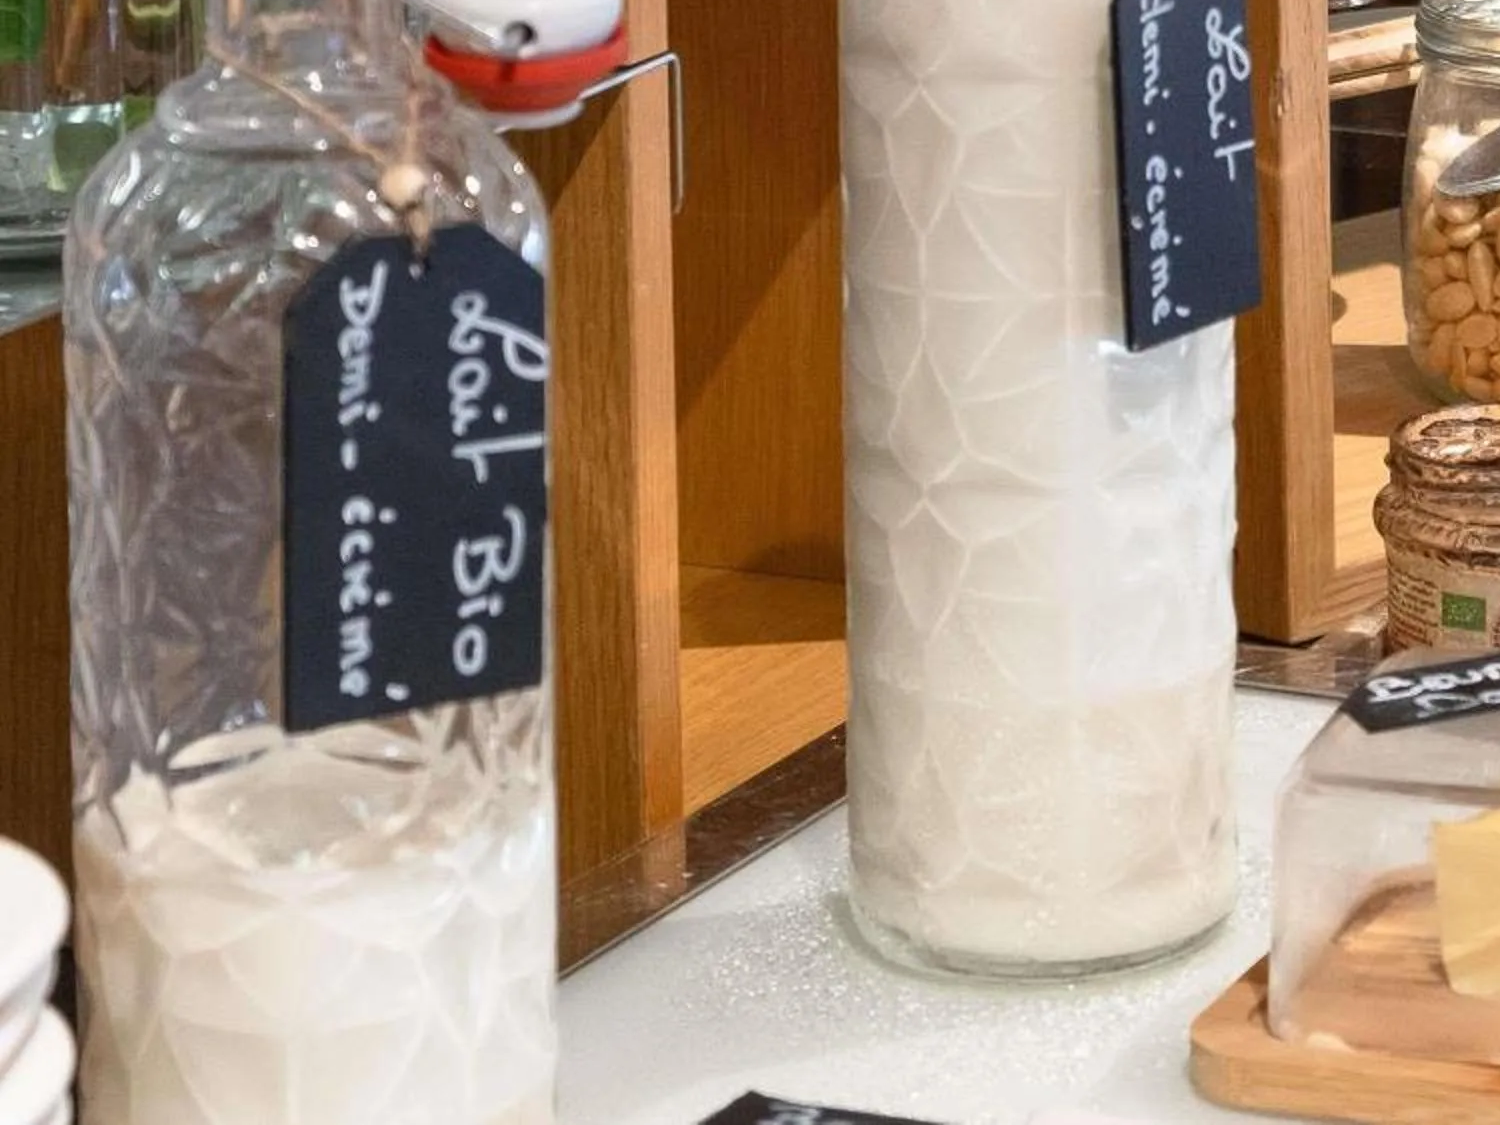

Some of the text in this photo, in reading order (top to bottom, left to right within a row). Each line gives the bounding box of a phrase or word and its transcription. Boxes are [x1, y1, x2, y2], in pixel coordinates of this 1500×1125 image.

[1205, 7, 1255, 181] Lait
[448, 290, 551, 677] Lait Bio
